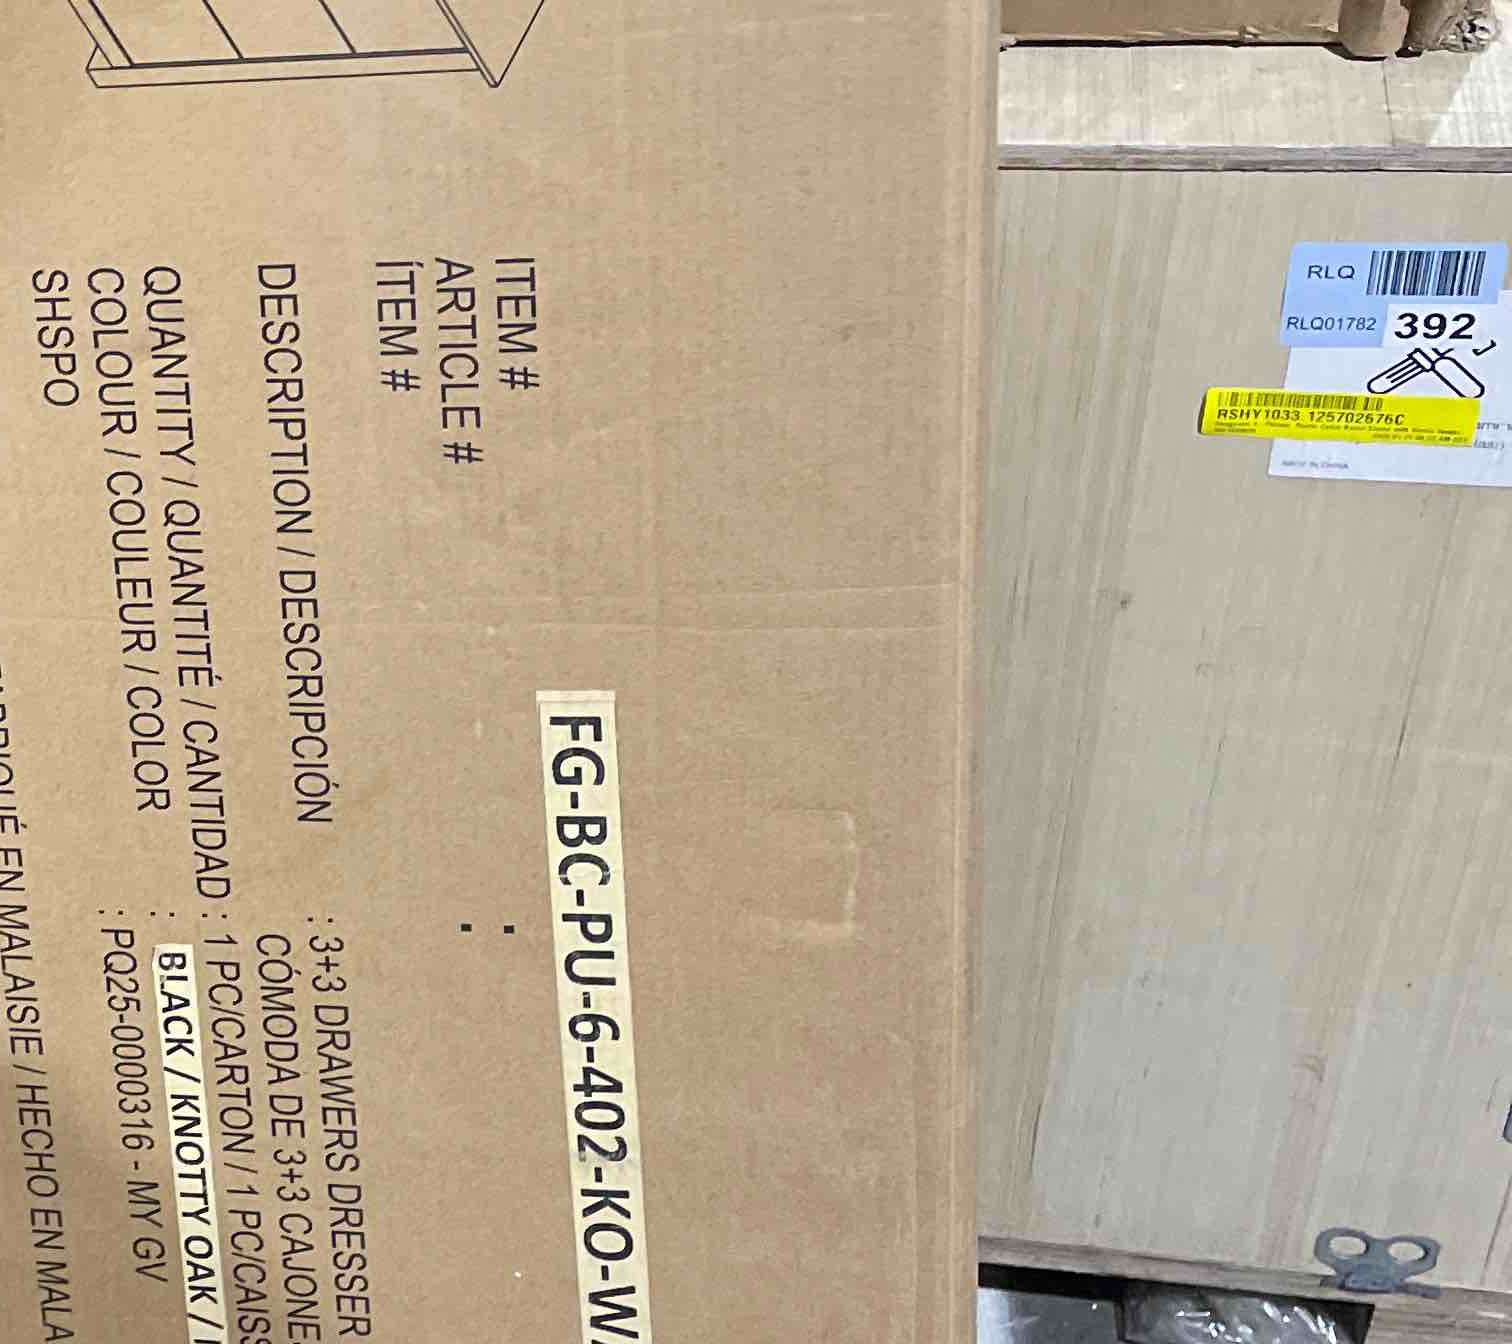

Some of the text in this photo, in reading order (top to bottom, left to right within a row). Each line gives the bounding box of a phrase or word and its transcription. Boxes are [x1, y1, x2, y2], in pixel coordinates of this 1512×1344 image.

[32, 269, 79, 406] SHSPO
[375, 261, 424, 392] ÍTEM #
[495, 258, 540, 390] ITEM #
[1287, 316, 1377, 332] RLQ01782
[1307, 265, 1356, 281] RLQ
[1394, 312, 1476, 340] 392
[88, 268, 137, 437] COLOUR
[143, 266, 196, 466] QUANTITY
[257, 264, 313, 533] DESCRIPTION
[434, 257, 481, 429] ARTICLE
[442, 442, 484, 464] #
[107, 471, 156, 654] COULEUR
[163, 500, 222, 687] QUANTITÉ
[126, 686, 171, 811] COLOR
[279, 570, 339, 822] DESCRIPCIÓN
[183, 720, 231, 899] CANTIDAD
[158, 953, 195, 1056] BLACK
[256, 934, 302, 1086] CÓMODA
[309, 936, 347, 992] 3+3
[101, 928, 154, 1150] PQ25-0000316
[205, 961, 256, 1154] PC/CARTON
[314, 1005, 360, 1172] DRAWERS
[16, 1084, 59, 1197] HECHO
[170, 1094, 210, 1225] KNOTTY
[268, 1094, 306, 1138] DE
[273, 1149, 310, 1202] 3+3
[30, 1208, 65, 1249] EN
[126, 1181, 163, 1228] MY
[133, 1237, 168, 1282] GV
[184, 1236, 217, 1304] OAK
[328, 1184, 371, 1336] DRESSER
